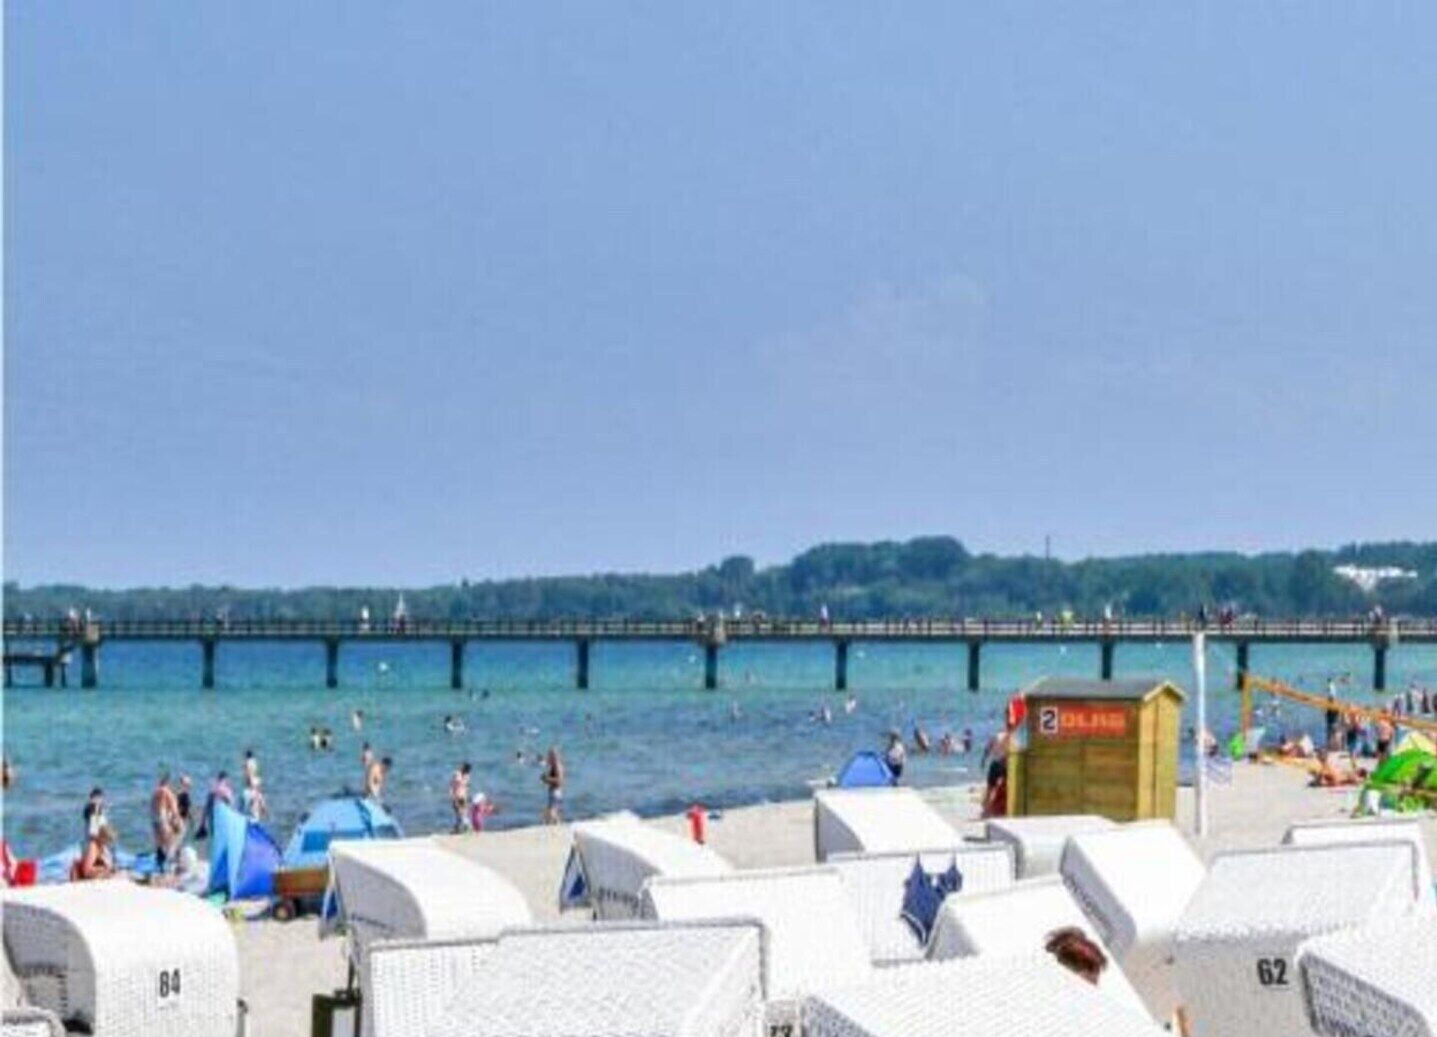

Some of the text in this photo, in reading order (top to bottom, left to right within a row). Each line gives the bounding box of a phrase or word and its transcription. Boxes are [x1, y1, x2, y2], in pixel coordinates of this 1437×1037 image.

[1042, 709, 1056, 731] 2
[158, 968, 182, 998] 84
[1256, 957, 1289, 986] 62
